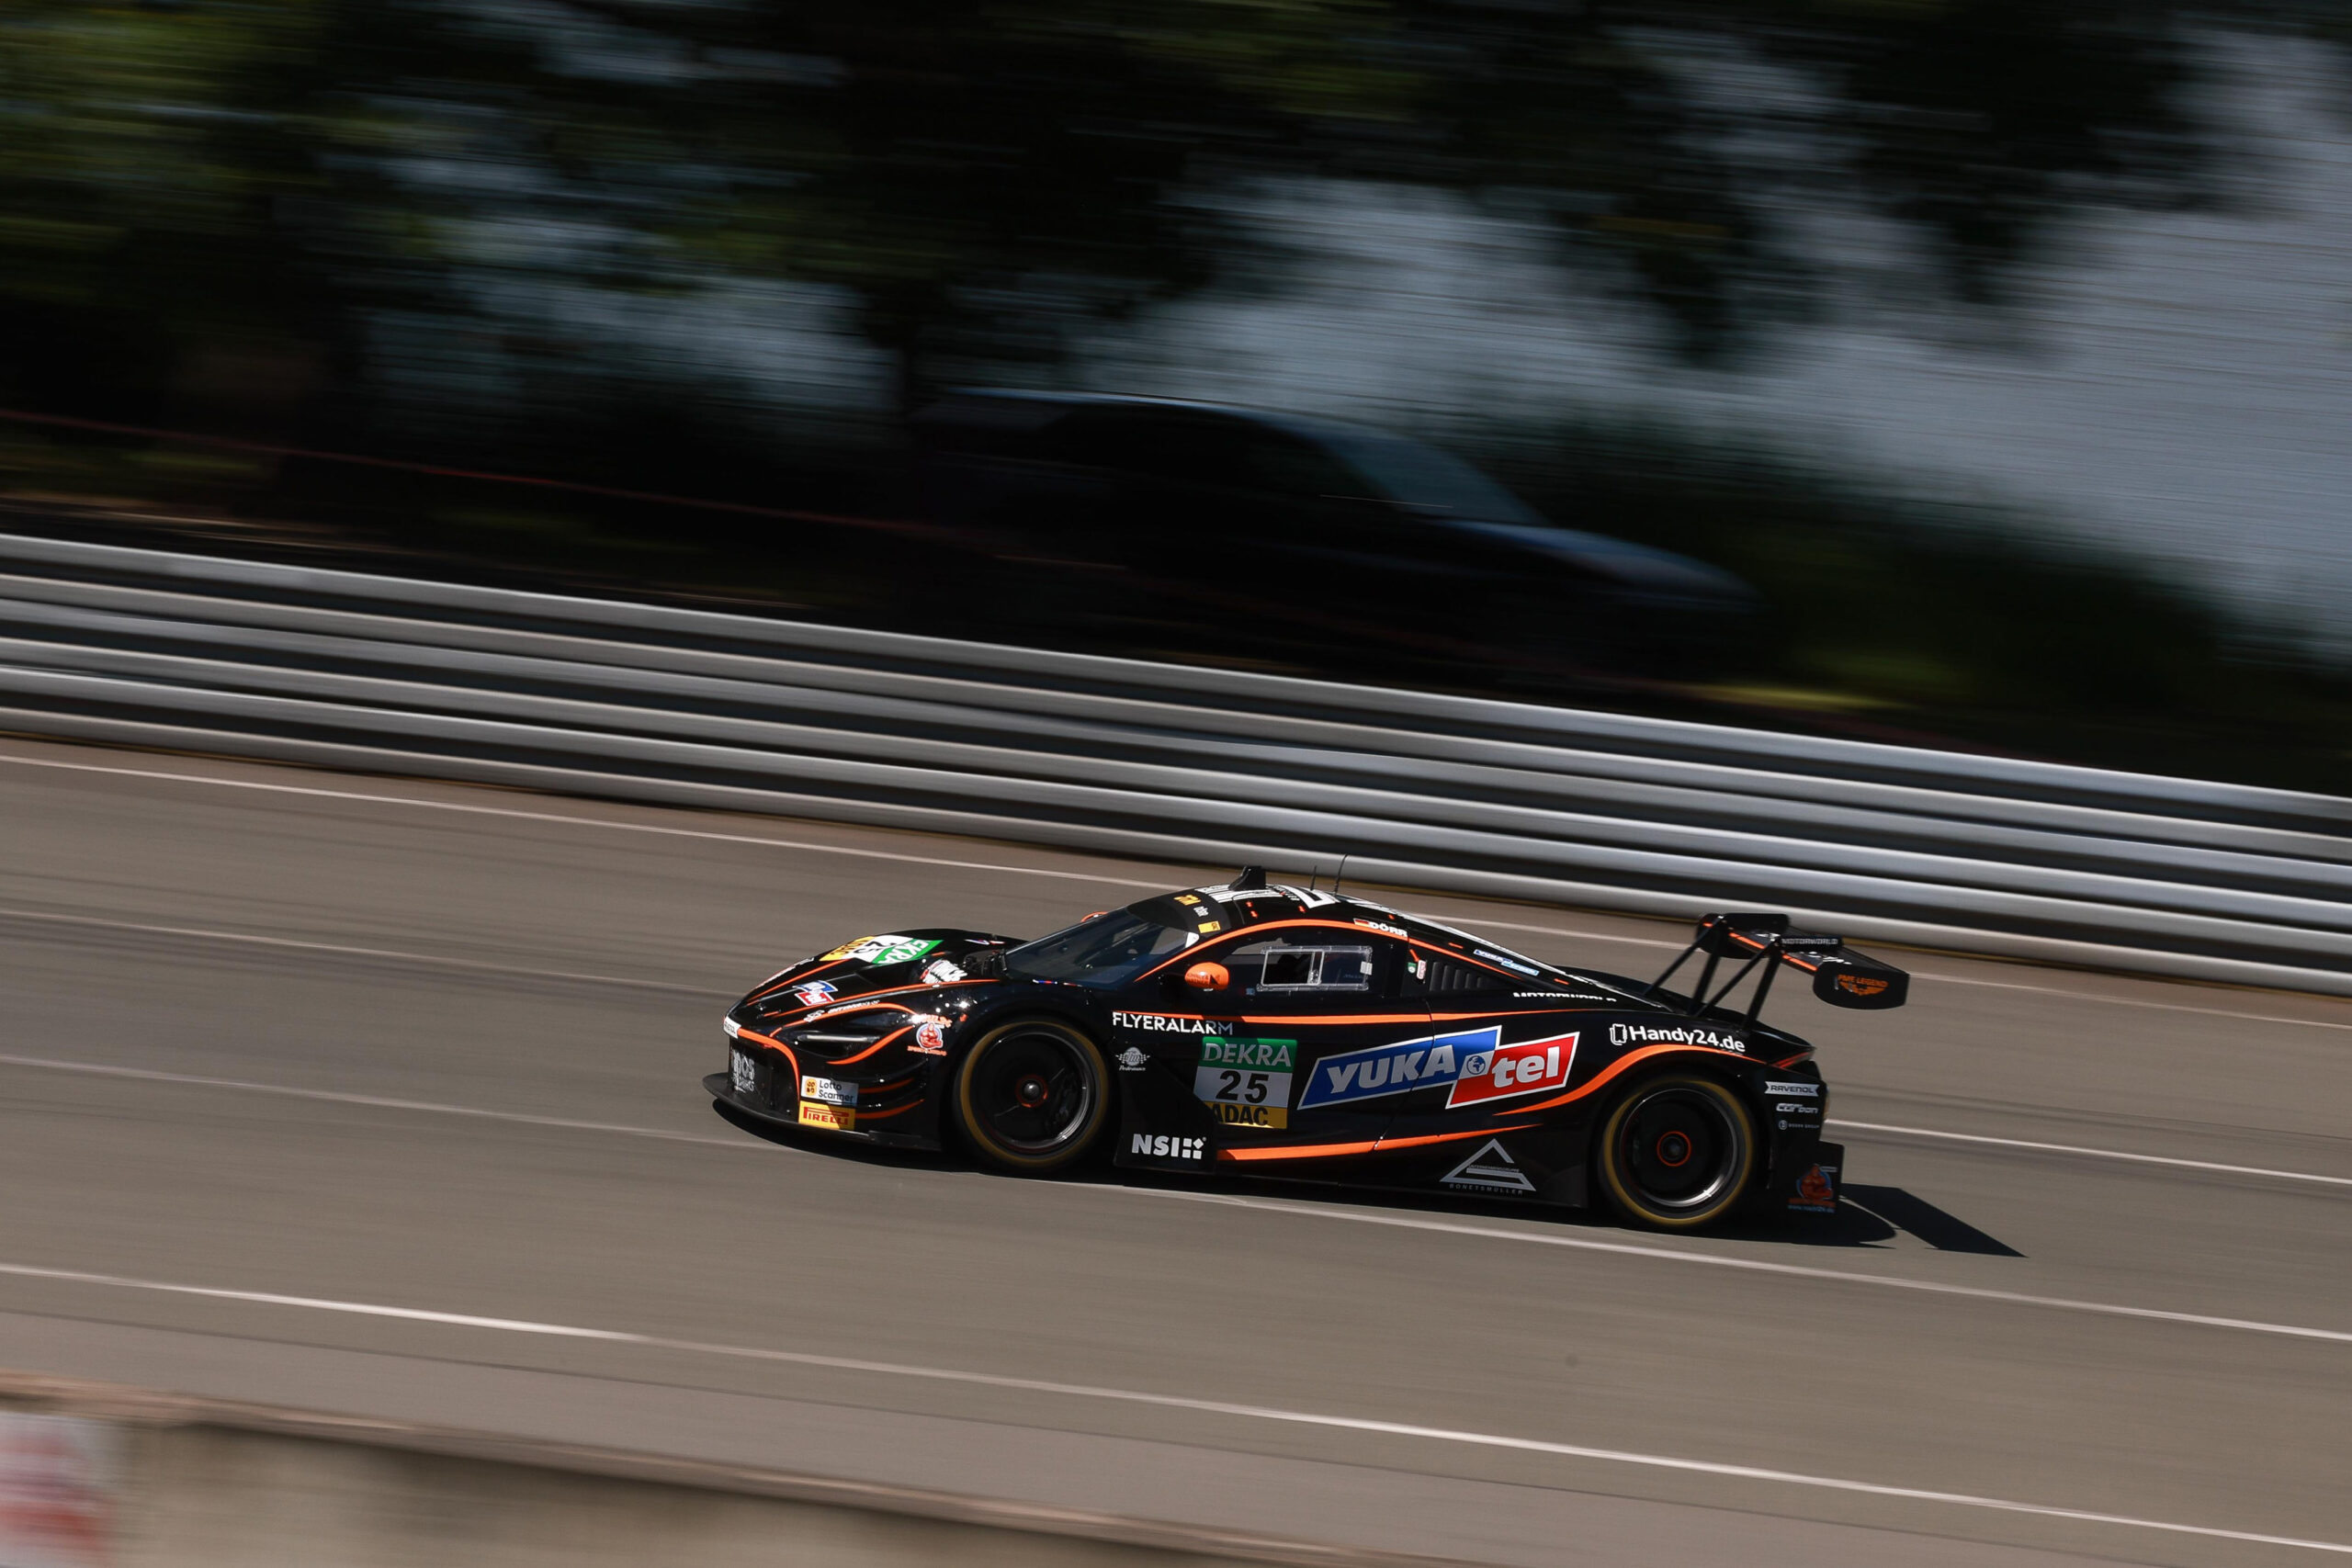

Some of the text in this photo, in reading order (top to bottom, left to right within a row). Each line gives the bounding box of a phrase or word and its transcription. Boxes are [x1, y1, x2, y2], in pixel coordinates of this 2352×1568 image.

[1112, 1011, 1232, 1035] FLYERALARM
[1628, 1025, 1746, 1053] Handy24.de
[1203, 1043, 1292, 1067] DEKRA
[1327, 1044, 1559, 1094] YUKA tel
[818, 1089, 854, 1102] Scanner
[819, 1080, 842, 1091] Lotto
[1216, 1070, 1269, 1103] 25
[1770, 1085, 1815, 1093] RAVENOL
[803, 1106, 850, 1125] PIRELLI
[1131, 1133, 1181, 1157] NSI
